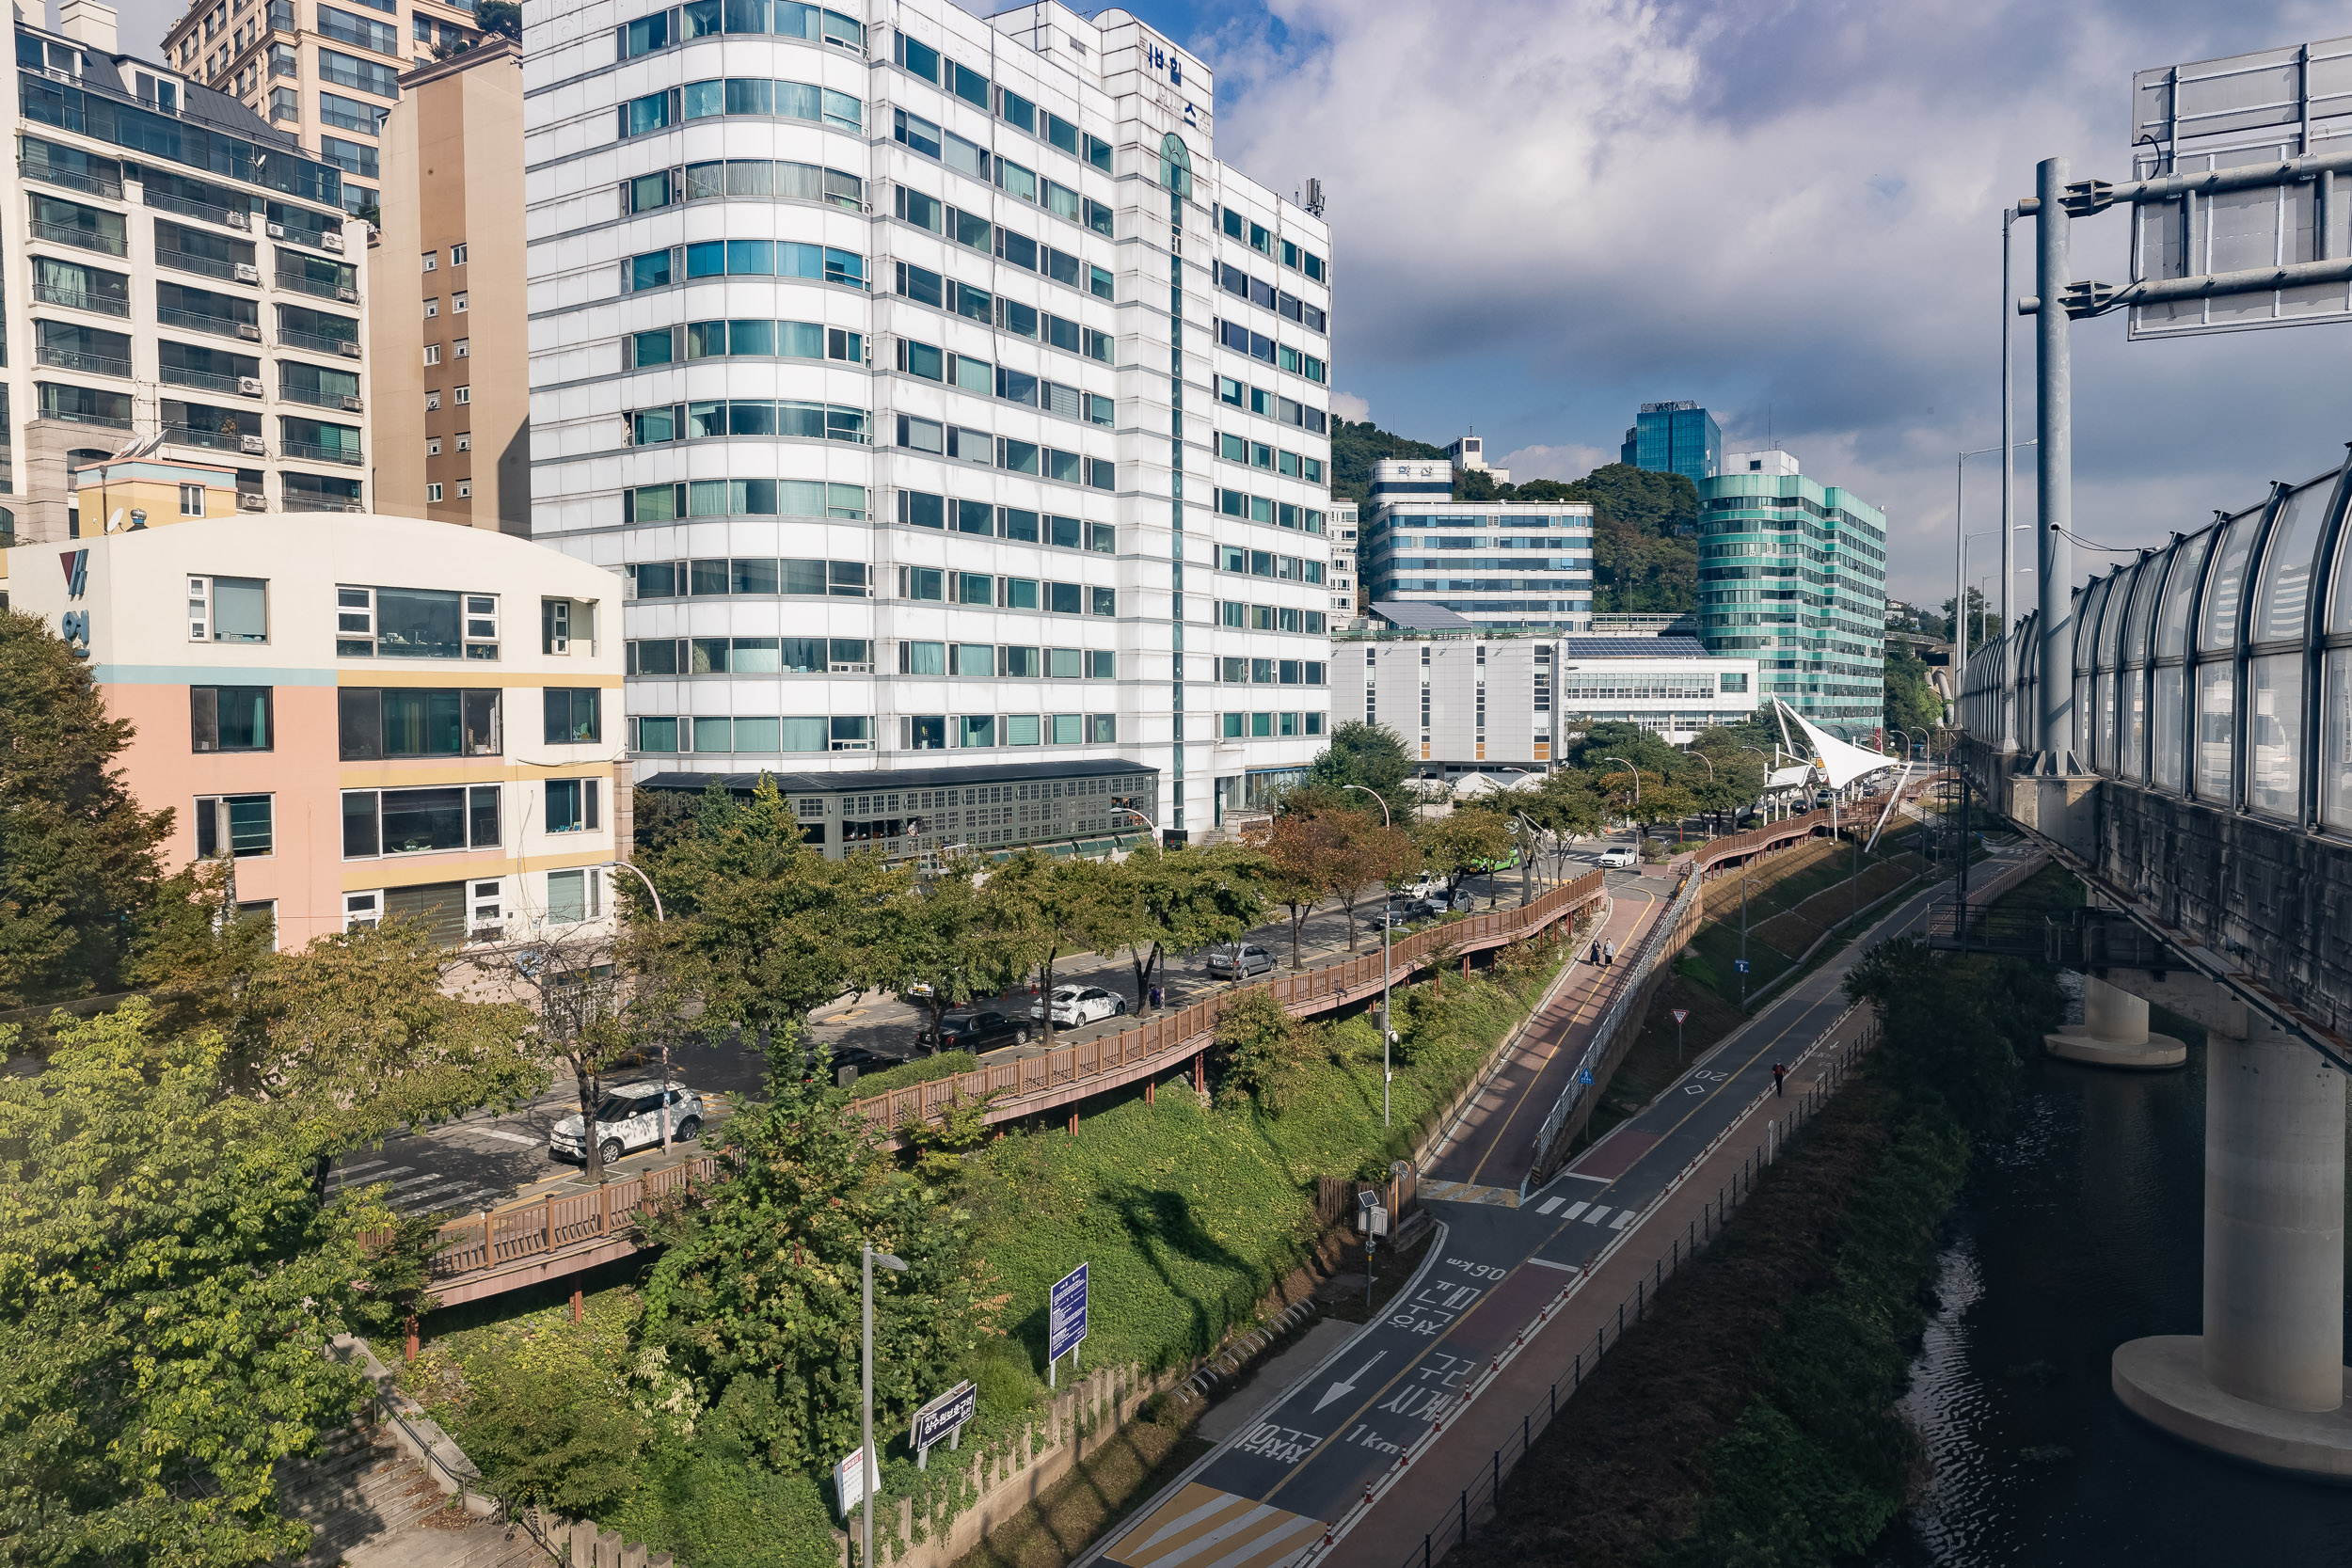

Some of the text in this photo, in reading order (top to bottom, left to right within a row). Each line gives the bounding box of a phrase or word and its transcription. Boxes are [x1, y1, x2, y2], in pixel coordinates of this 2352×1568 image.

[1655, 402, 1680, 411] VISTA
[1694, 1069, 1729, 1083] 20
[924, 1394, 974, 1435] 상수원보호구역
[1377, 1384, 1455, 1422] 시계
[1233, 1422, 1324, 1465] 천천히
